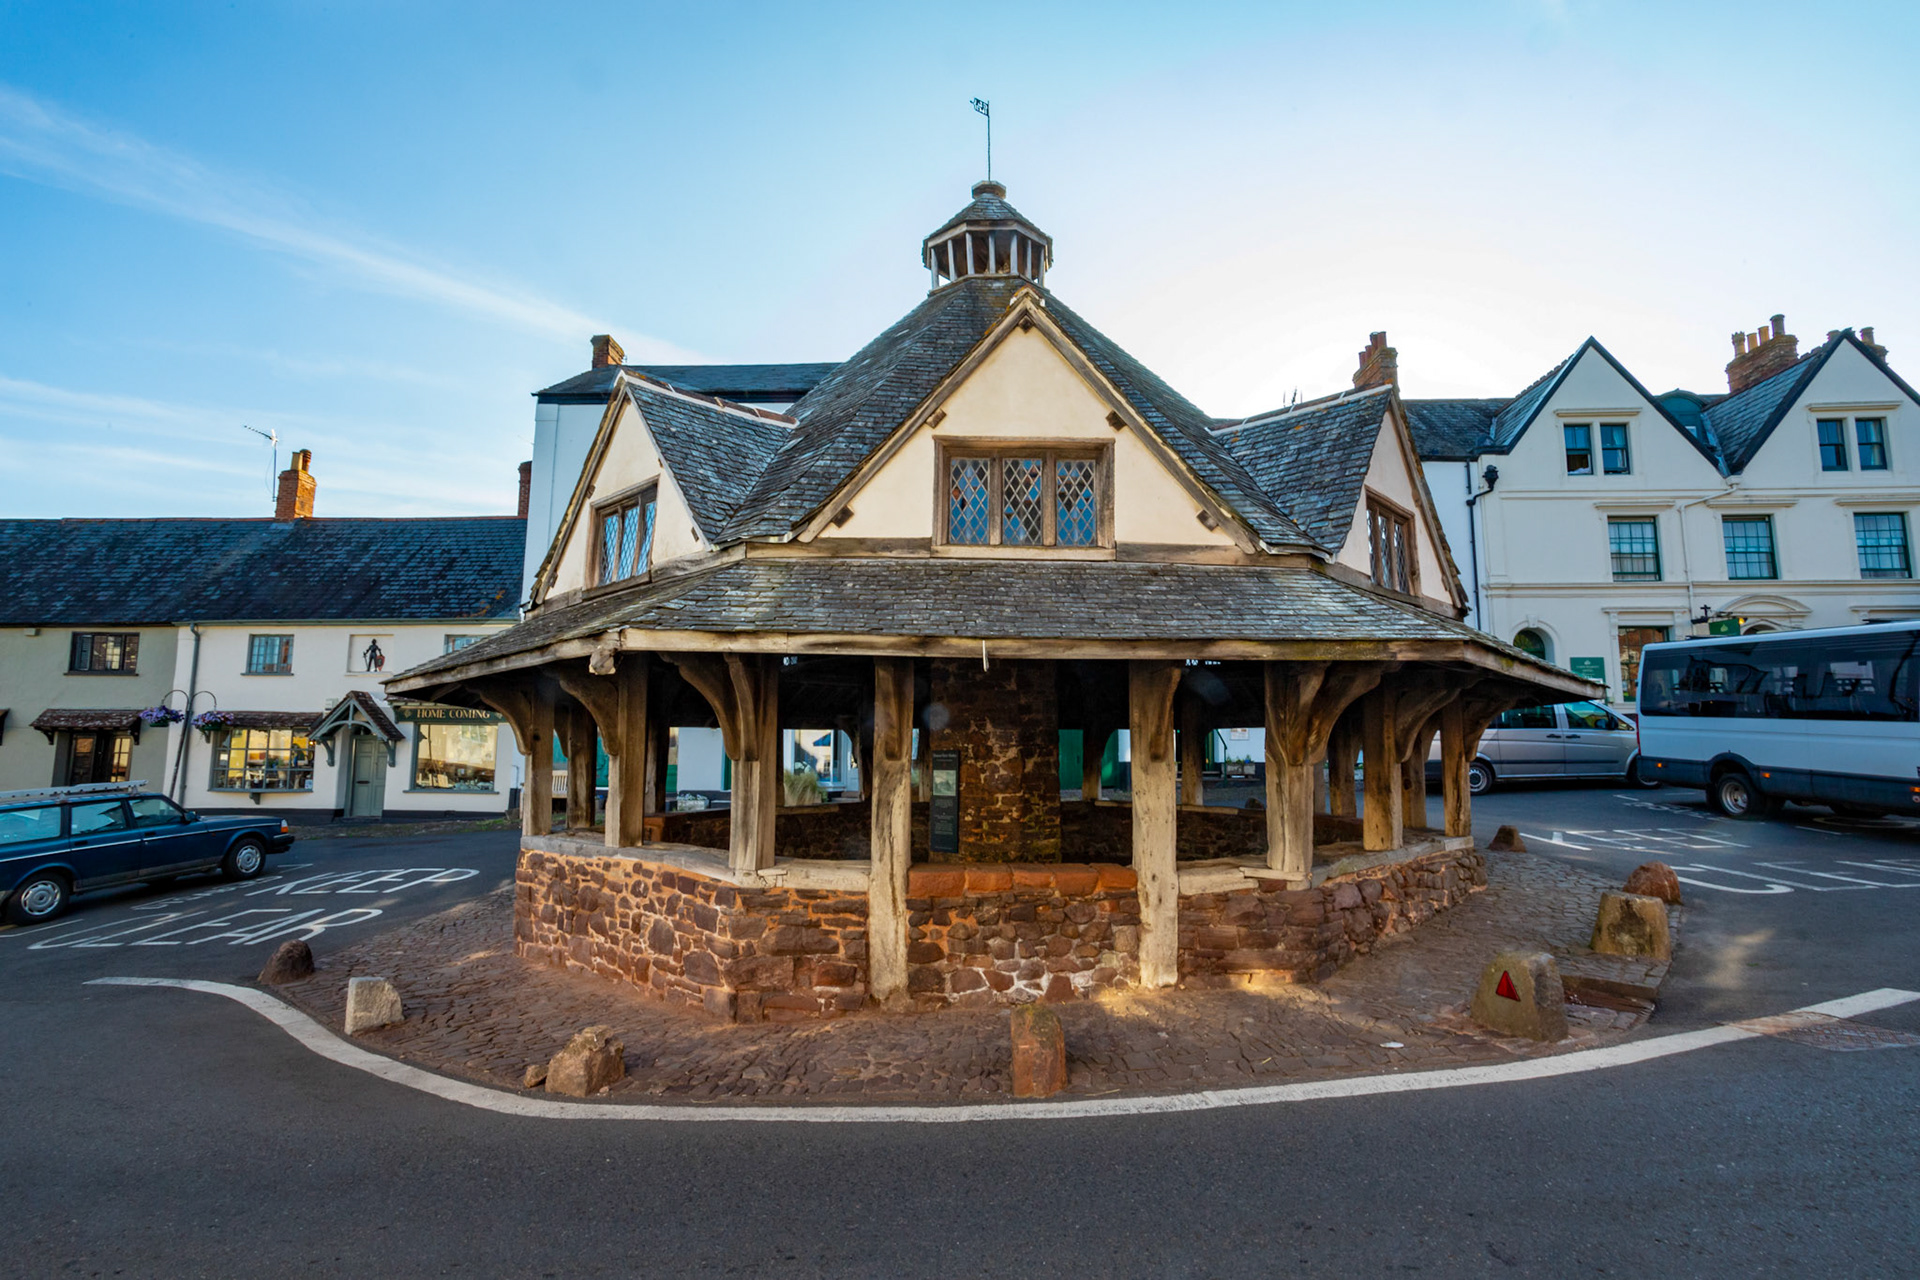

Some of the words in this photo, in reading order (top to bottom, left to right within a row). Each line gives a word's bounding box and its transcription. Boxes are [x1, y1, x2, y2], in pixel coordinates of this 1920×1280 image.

[417, 709, 446, 718] HOME
[449, 709, 490, 718] COMING
[245, 868, 480, 896] KEEP
[27, 908, 383, 950] CLEAR
